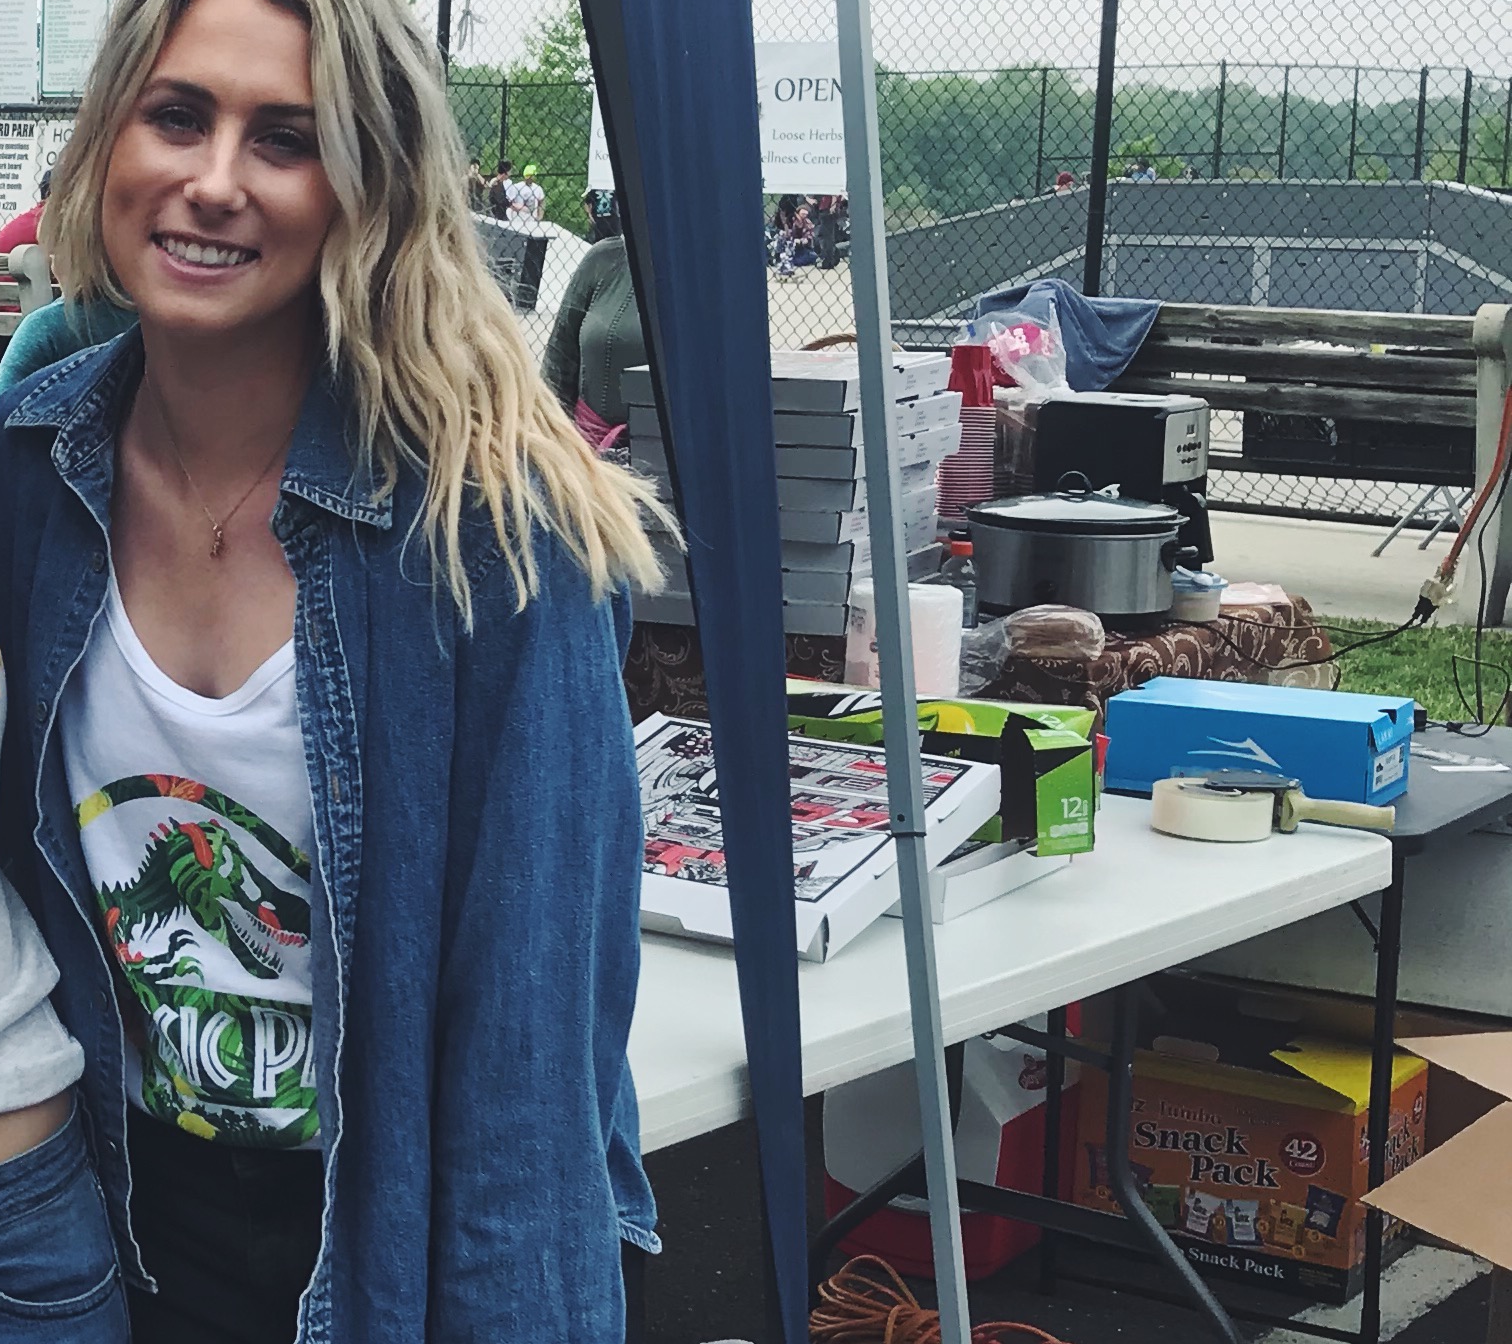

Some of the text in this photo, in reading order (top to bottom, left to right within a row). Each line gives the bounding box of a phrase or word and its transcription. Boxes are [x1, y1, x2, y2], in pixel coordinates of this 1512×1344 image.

[11, 123, 35, 138] PARK
[772, 128, 843, 141] Loose Herbs
[760, 151, 842, 165] ellness Center
[1133, 1120, 1251, 1157] Snack
[1284, 1138, 1319, 1161] 42
[1189, 1154, 1281, 1189] Pack
[1188, 1247, 1241, 1271] Snack
[1243, 1257, 1285, 1279] Pack
